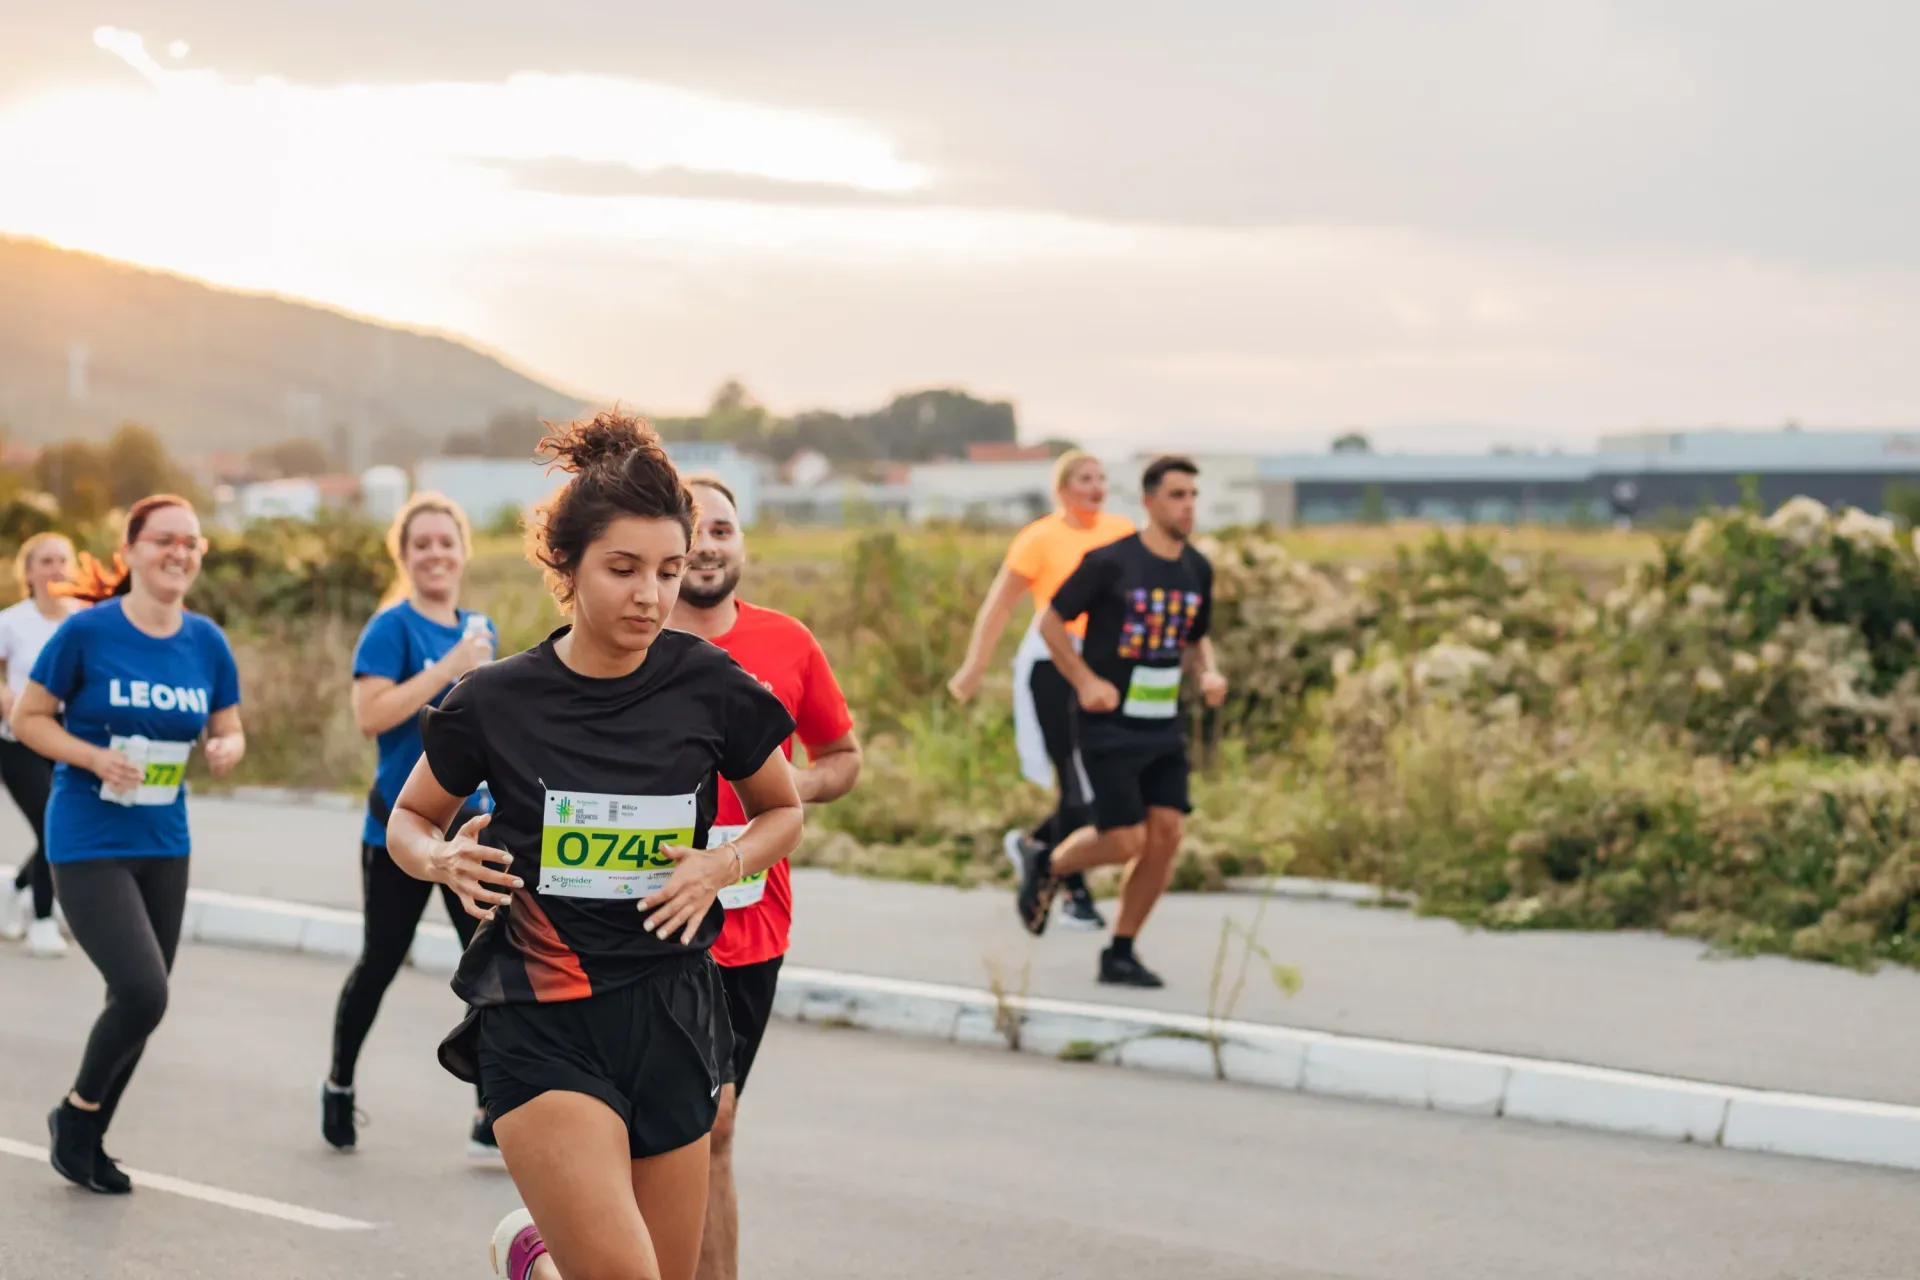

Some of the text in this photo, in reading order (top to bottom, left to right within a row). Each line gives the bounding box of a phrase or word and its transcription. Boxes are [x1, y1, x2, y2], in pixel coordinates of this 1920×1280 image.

[109, 679, 208, 714] LEONI
[143, 764, 178, 786] 77
[557, 831, 679, 868] 0745
[551, 875, 593, 888] Schneider
